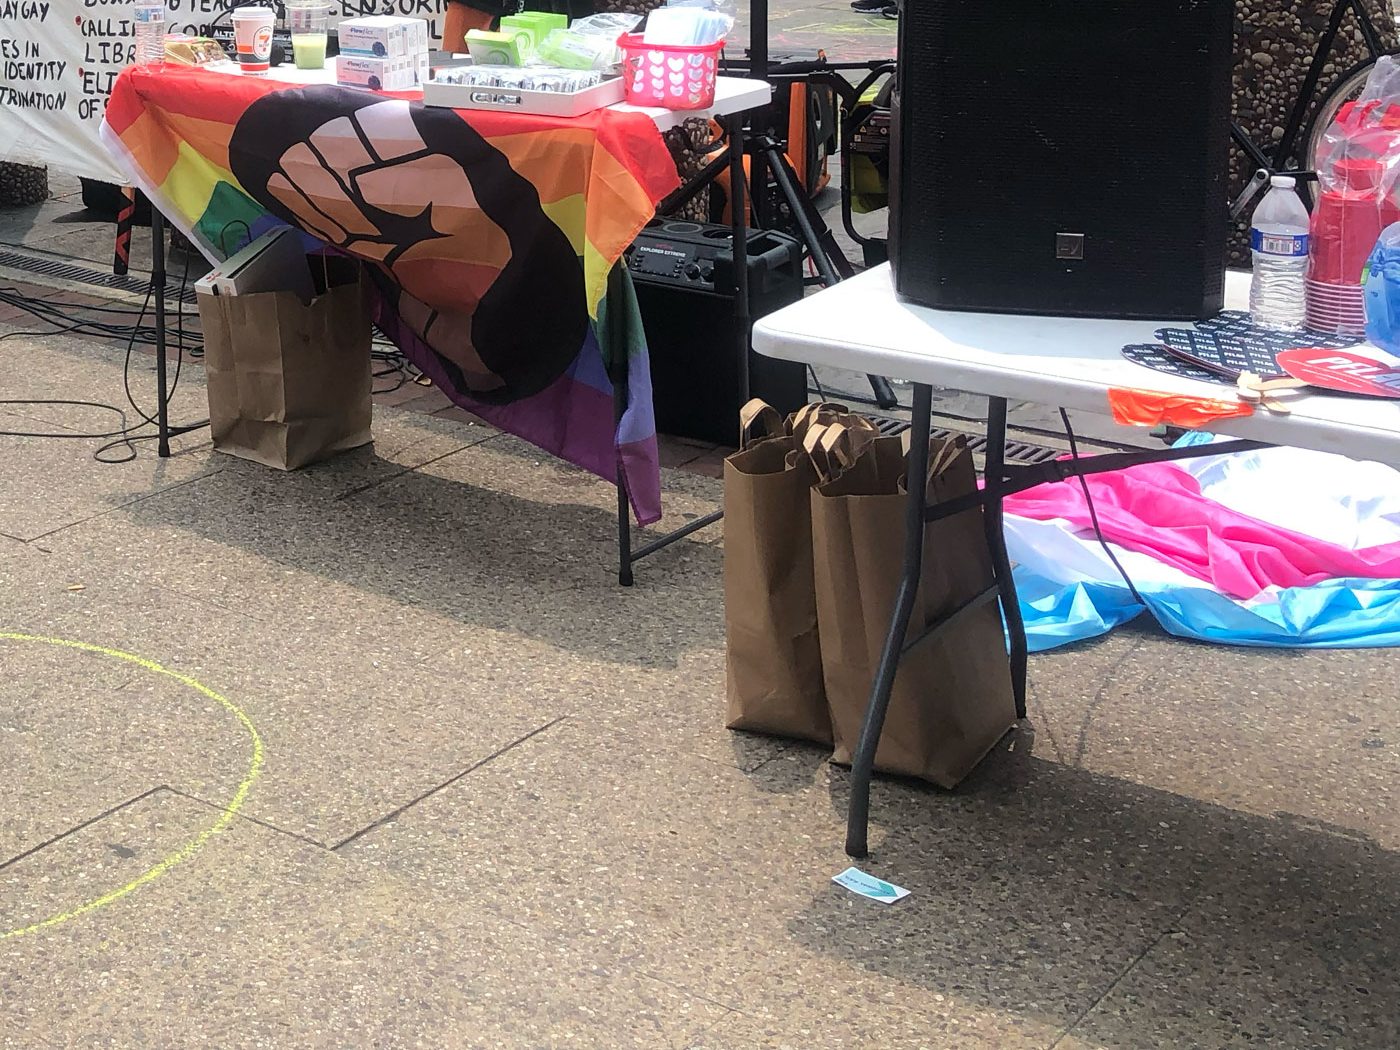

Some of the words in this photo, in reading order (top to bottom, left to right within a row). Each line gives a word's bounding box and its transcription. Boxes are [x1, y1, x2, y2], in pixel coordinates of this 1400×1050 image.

[21, 1, 50, 23] GAY
[25, 40, 40, 58] IN
[4, 61, 67, 81] IDENTITY
